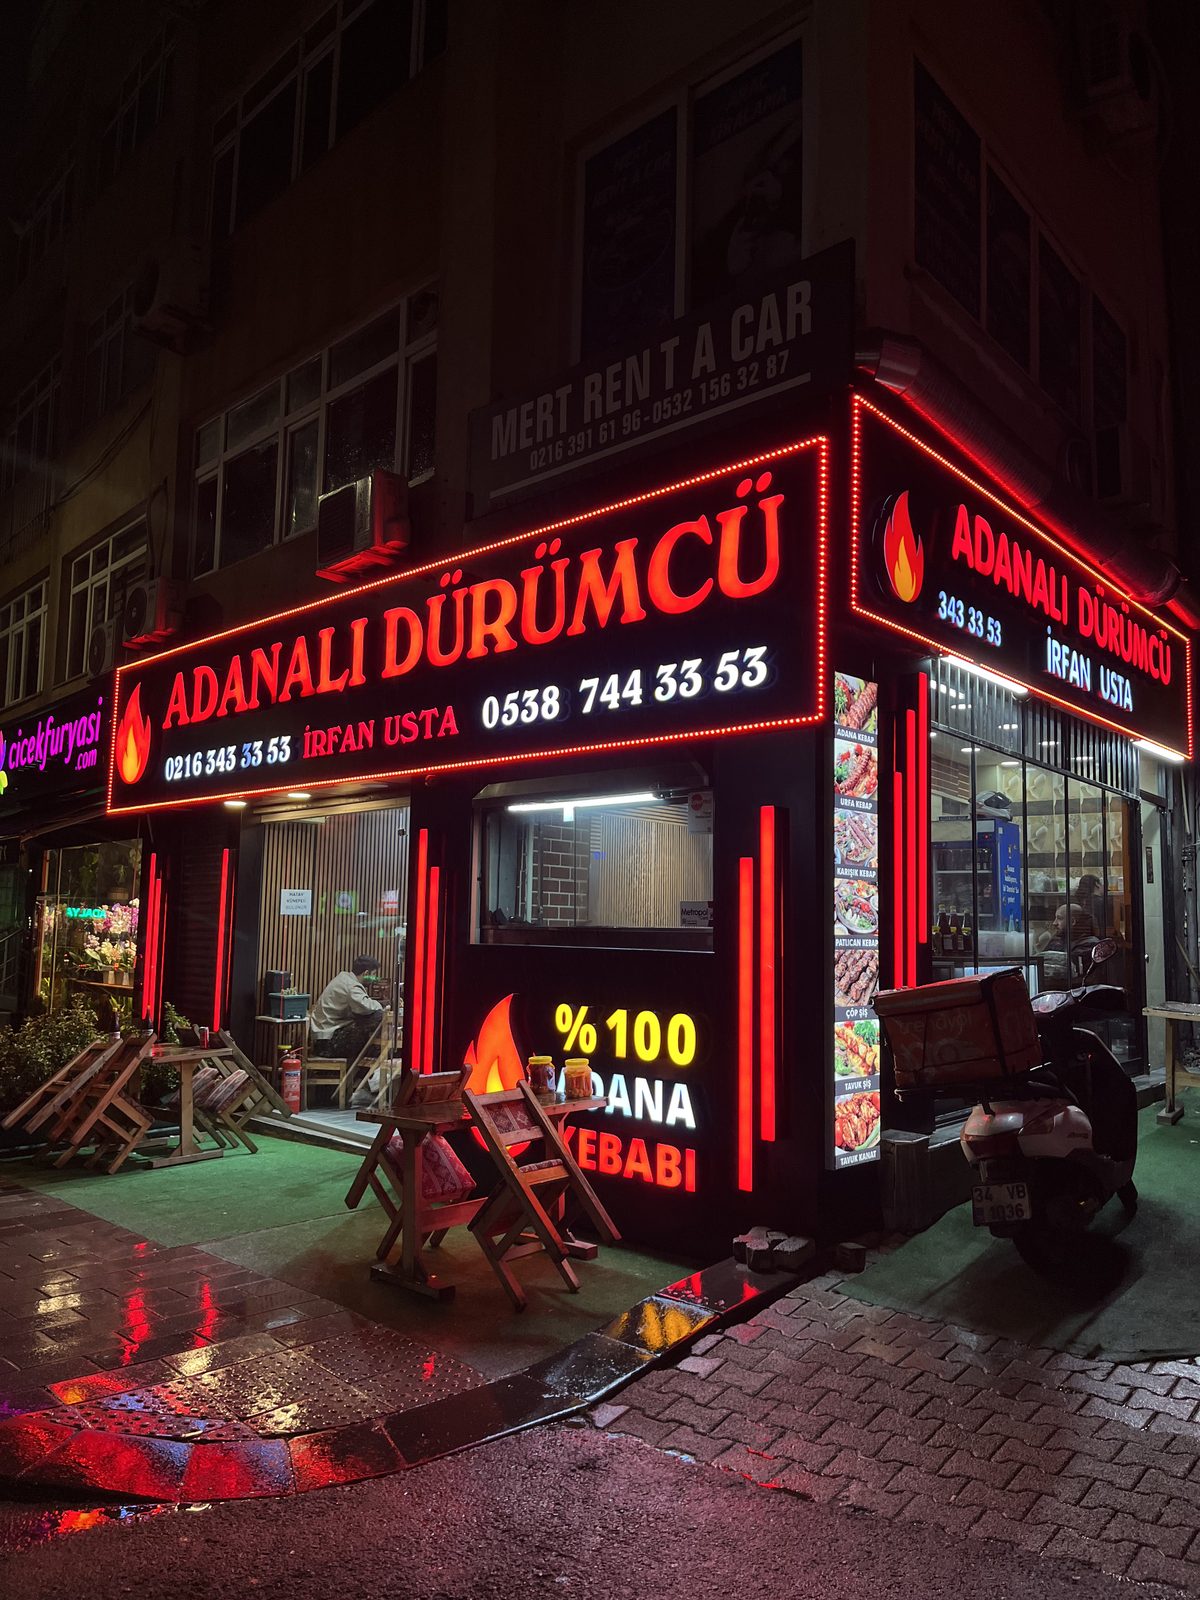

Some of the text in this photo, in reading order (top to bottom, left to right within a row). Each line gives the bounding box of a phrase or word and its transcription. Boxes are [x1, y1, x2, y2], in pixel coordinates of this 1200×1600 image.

[491, 384, 572, 460] MERT
[691, 322, 717, 380] A
[730, 280, 812, 362] CAR
[530, 439, 563, 471] 0216
[567, 432, 593, 456] 391
[599, 422, 616, 445] 61
[700, 373, 731, 406] 156
[736, 362, 760, 391] 32
[766, 349, 789, 379] 87
[162, 471, 785, 730] ADANALI DÜRÜMCÜ
[938, 590, 1001, 647] 343 33 53
[952, 504, 1171, 685] ADANALI DÜRÜMCÜ
[482, 646, 768, 729] 0538 744 33 53
[1047, 625, 1133, 712] İRFAN USTA
[9, 696, 103, 771] cicekfuryasi
[165, 735, 292, 783] 0216 343 33 53
[302, 705, 459, 759] İRFAN USTA
[837, 728, 875, 744] ADANA KEBAP
[840, 798, 873, 810] URFA KEBAP
[860, 869, 876, 878] KEBAP
[862, 938, 879, 947] KEBAP
[845, 1008, 858, 1018] ÇÖP
[556, 1066, 696, 1129] ANA
[844, 1081, 862, 1090] TAVUK
[840, 1151, 877, 1166] TAVUK KANAT
